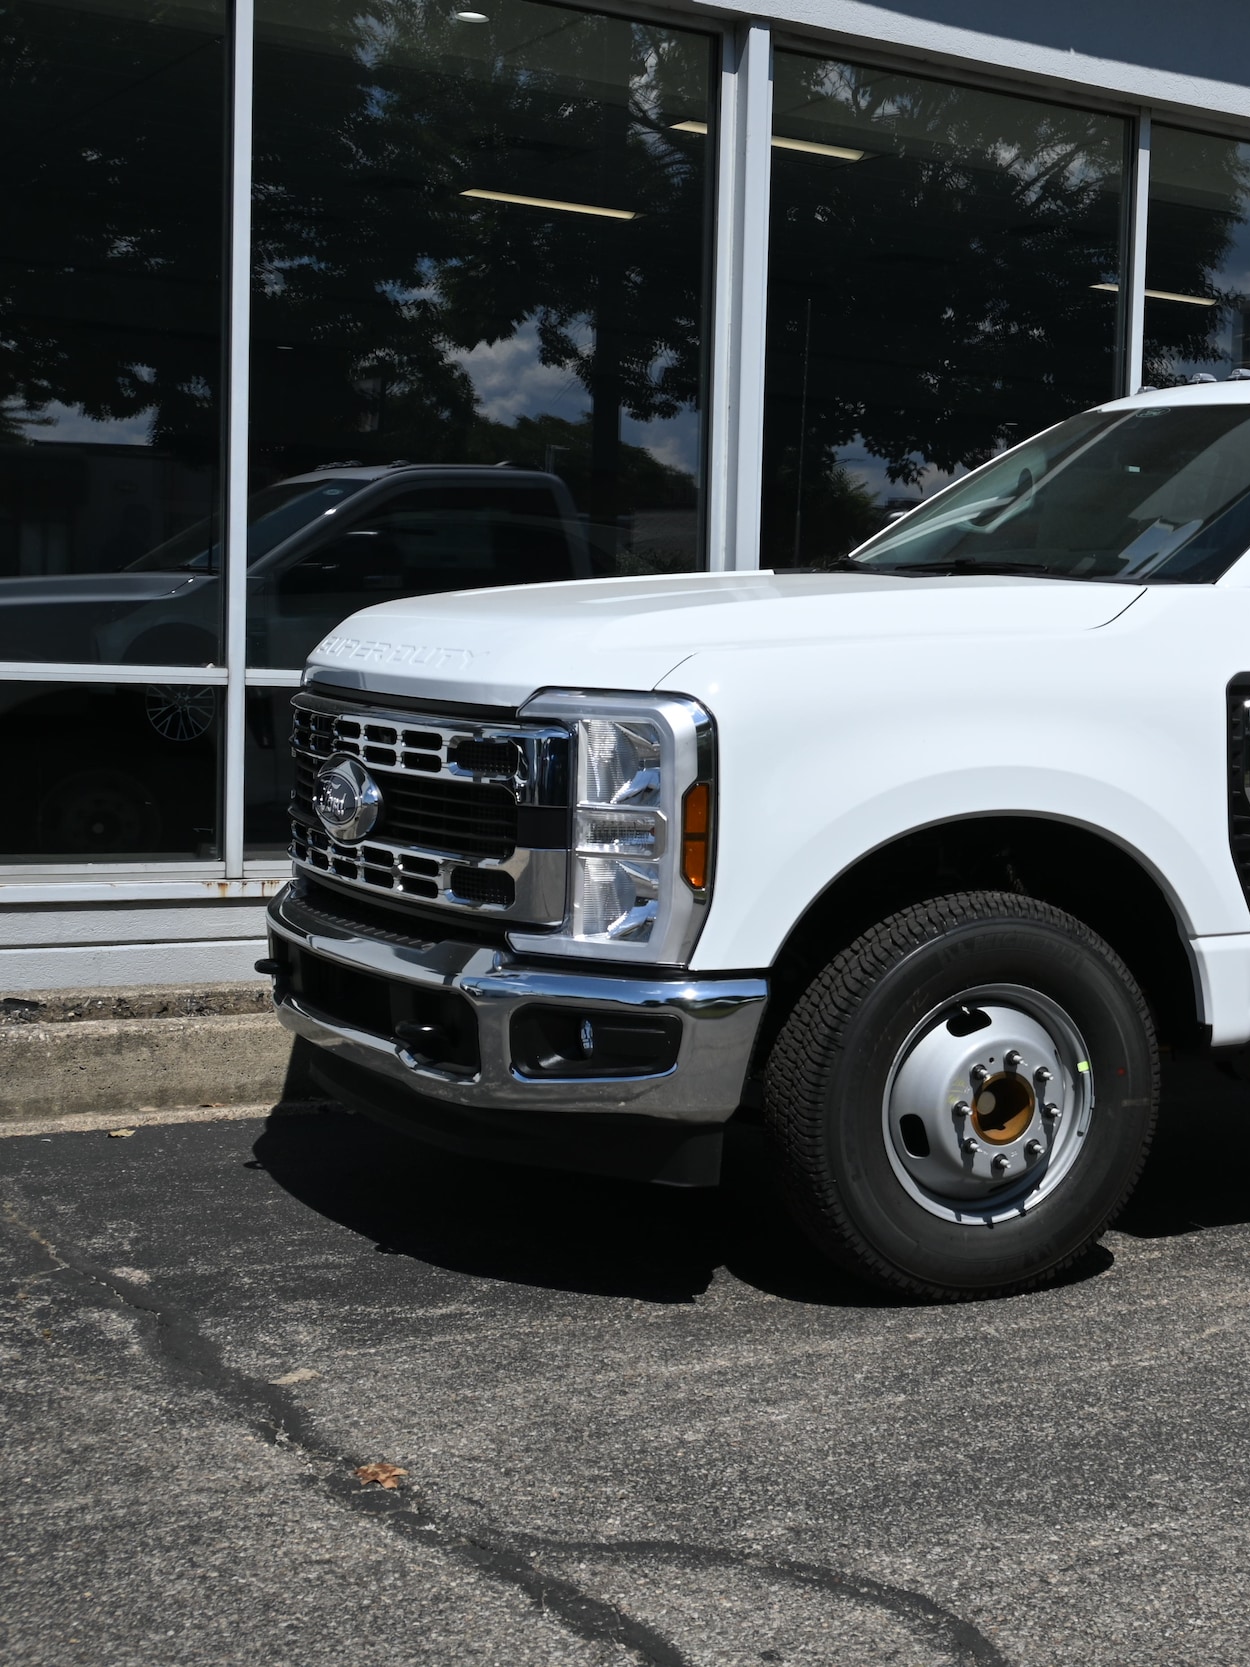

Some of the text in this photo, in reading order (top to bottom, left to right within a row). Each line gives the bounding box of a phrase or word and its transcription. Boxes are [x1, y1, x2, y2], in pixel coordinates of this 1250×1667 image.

[316, 636, 475, 670] SUPER DUTY
[317, 778, 348, 817] Ford
